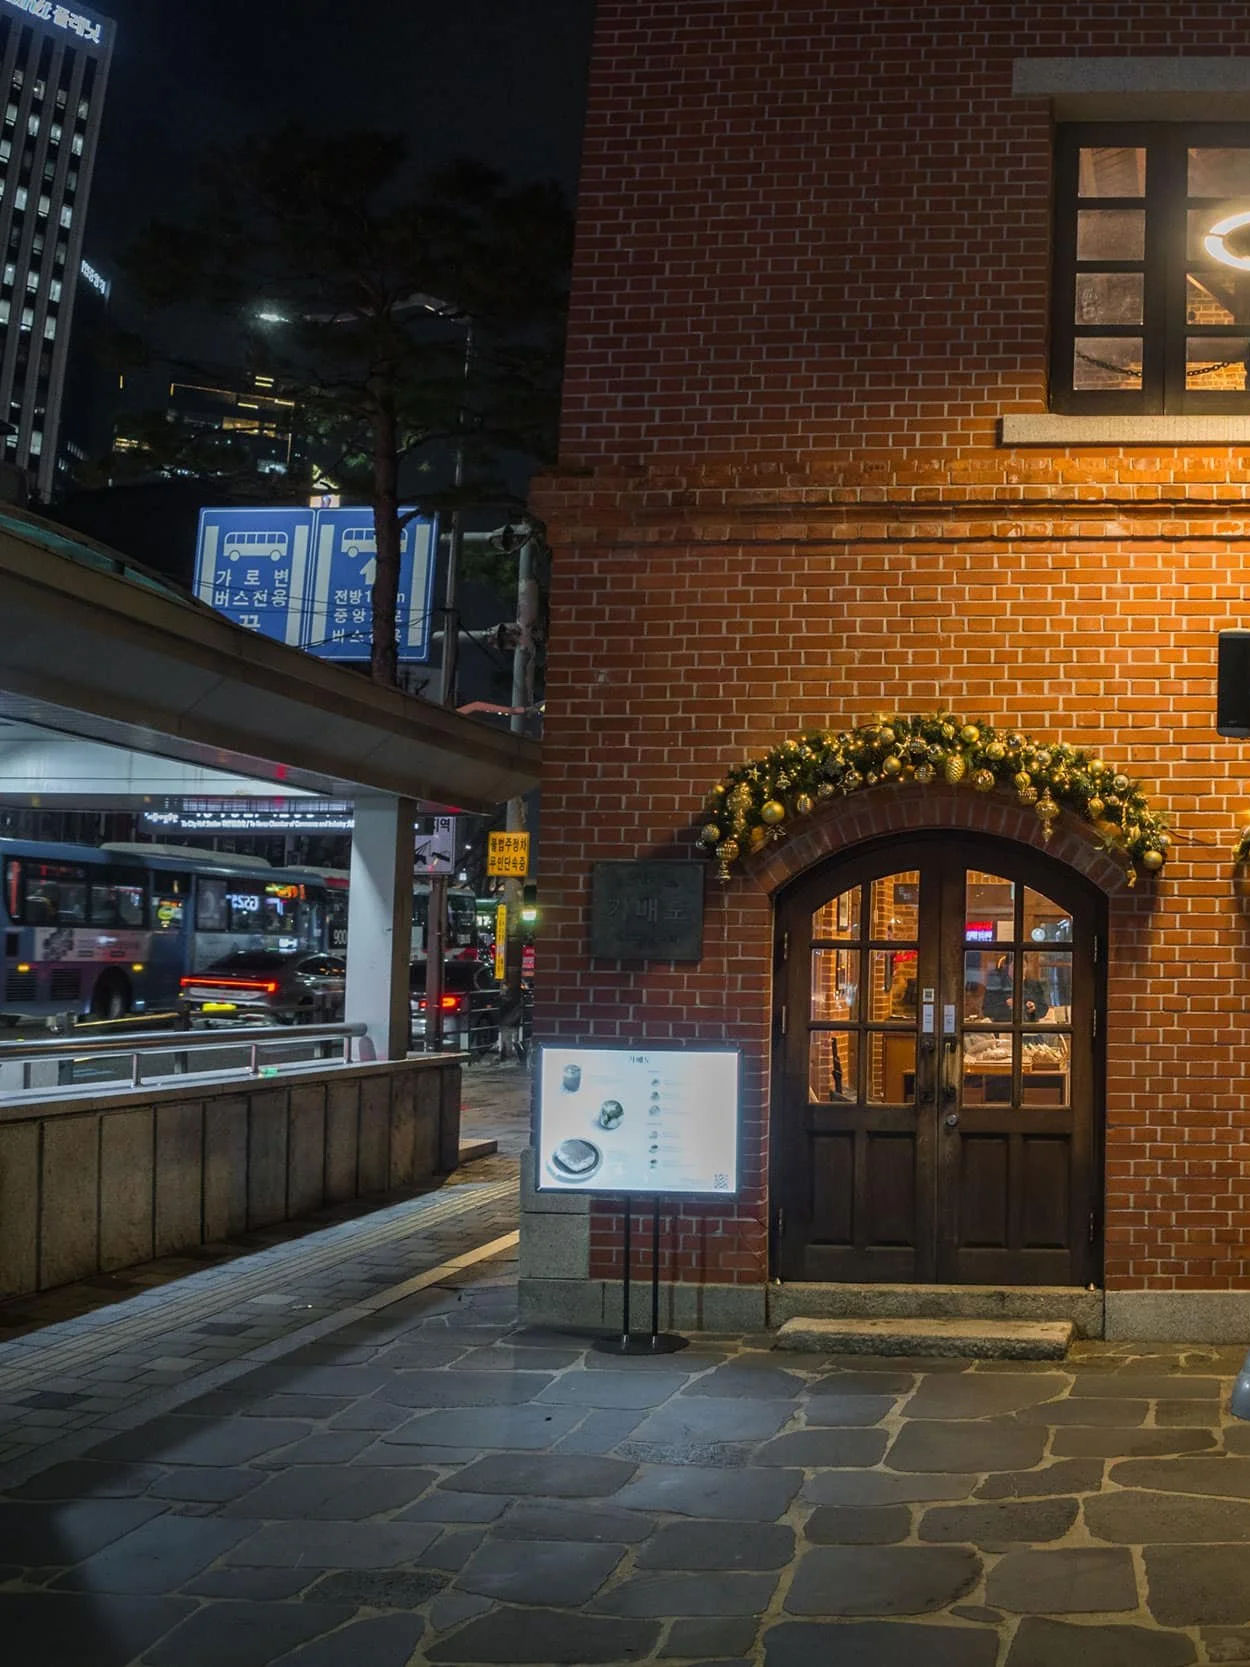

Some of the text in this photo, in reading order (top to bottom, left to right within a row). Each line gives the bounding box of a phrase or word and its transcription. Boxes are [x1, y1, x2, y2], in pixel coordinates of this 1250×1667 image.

[214, 588, 289, 608] 버스전용
[491, 837, 527, 852] 불법주정차
[489, 856, 525, 871] 무인단속중
